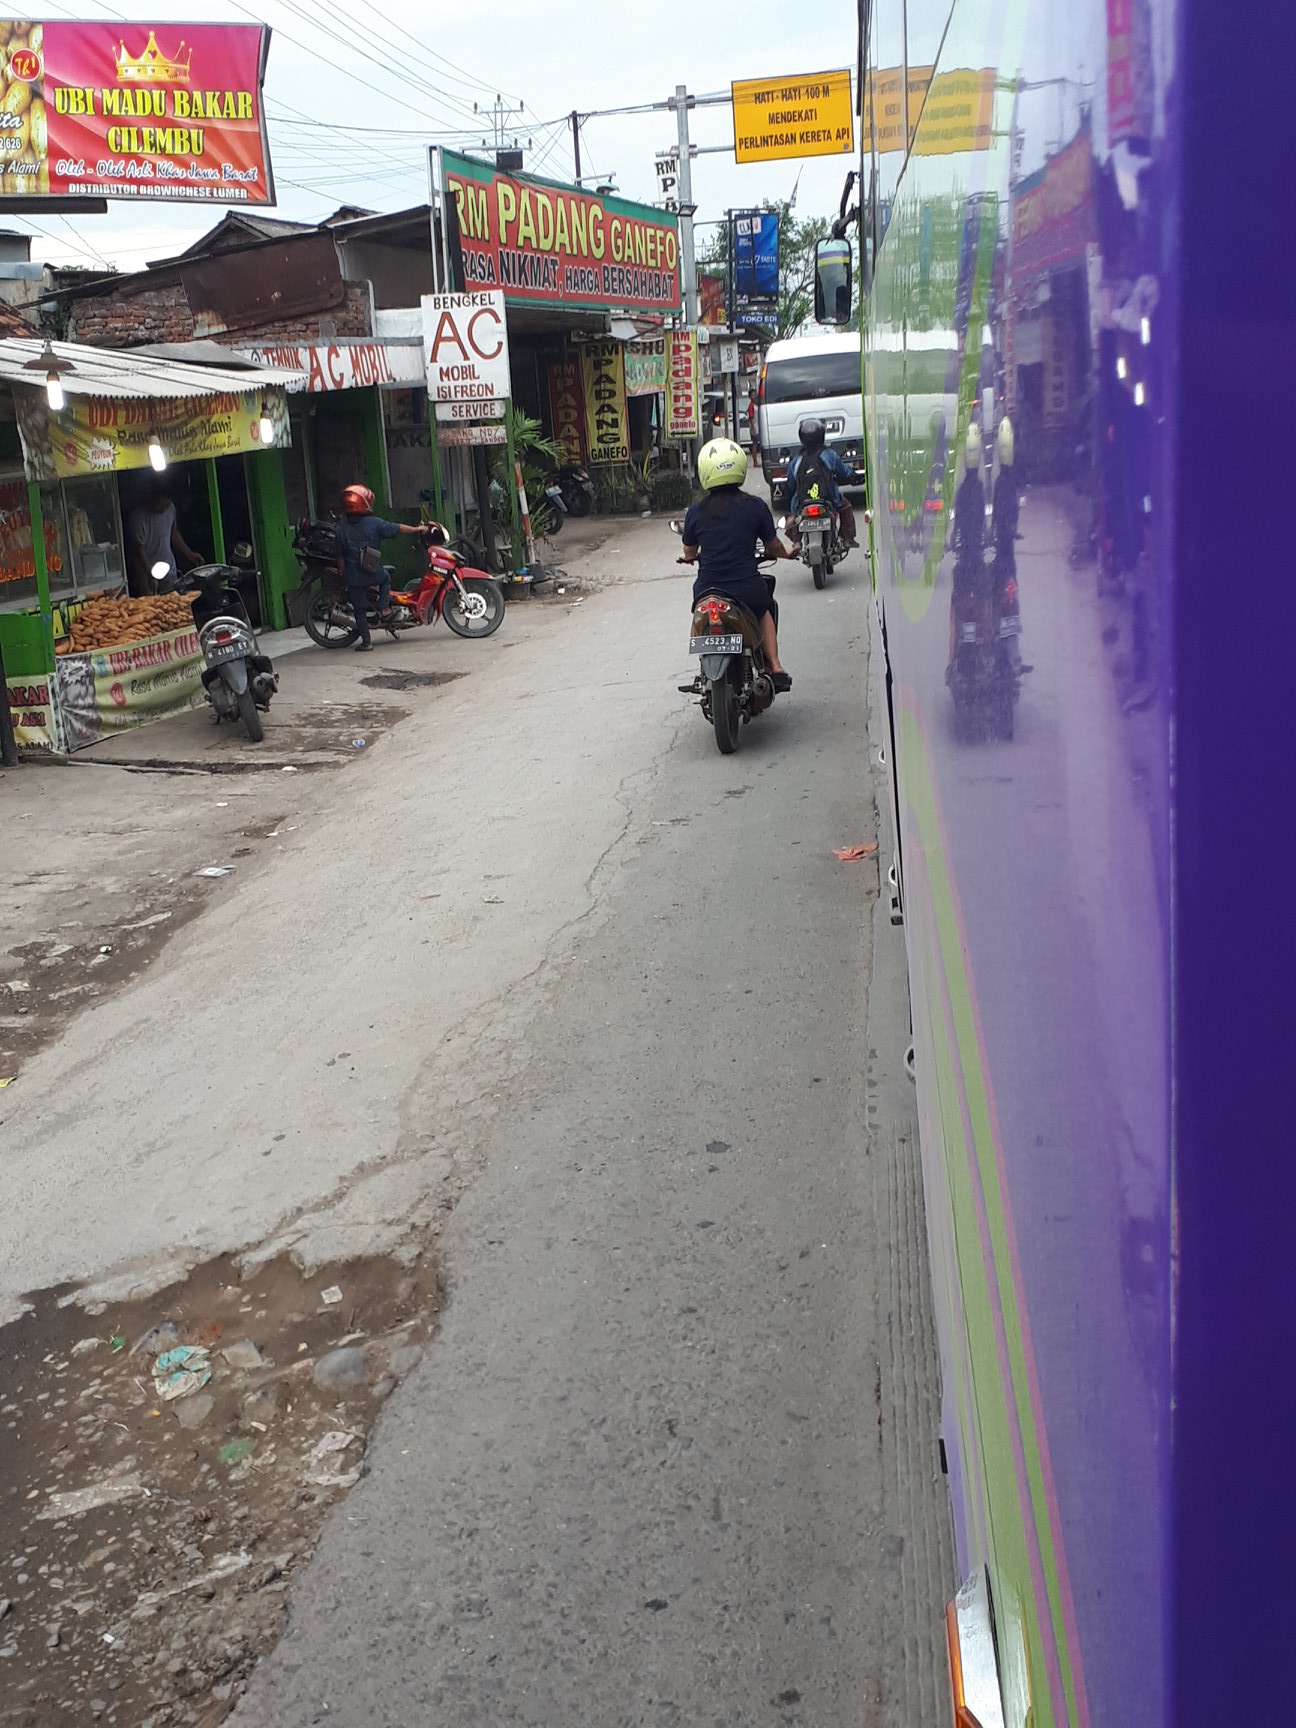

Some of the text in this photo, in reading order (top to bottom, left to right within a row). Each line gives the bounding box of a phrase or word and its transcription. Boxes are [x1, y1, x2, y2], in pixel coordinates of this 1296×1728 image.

[54, 87, 254, 119] UBI MADU BAKAR
[754, 90, 774, 105] HATI
[781, 87, 801, 102] HATI
[806, 86, 821, 100] 100
[822, 84, 830, 98] M
[768, 108, 818, 125] MENDEKATI
[6, 137, 21, 149] 626
[106, 126, 205, 156] CILEMBU
[738, 126, 850, 150] PERLINTASAN KERETA API
[8, 159, 41, 174] Alami
[56, 159, 85, 176] Oleh
[97, 160, 125, 178] Oleh
[126, 161, 154, 178] Asli
[157, 161, 186, 179] Khas
[188, 163, 219, 181] Jawa
[222, 165, 258, 181] Barat
[655, 159, 677, 176] RM
[68, 183, 248, 198] DISTRIBUTOR BROWNCHESE LUMER
[448, 179, 677, 270] RM PADANG GANEFO
[461, 250, 497, 284] RASA
[498, 248, 564, 297] NIKMAT,
[565, 264, 601, 293] HARGA
[601, 263, 674, 301] BERSAHABAT
[433, 293, 495, 310] BENGKEL
[765, 315, 777, 323] EDI
[430, 307, 503, 363] AC
[672, 331, 690, 341] RM
[585, 343, 619, 358] RM
[309, 345, 344, 392] AC
[349, 344, 393, 386] MOBIL
[439, 365, 480, 382] MOBIL
[437, 383, 495, 400] ISI FREON
[452, 402, 496, 418] SERVICE
[593, 359, 621, 444] PADANG
[591, 446, 628, 461] GANEFO
[691, 639, 696, 647] S
[705, 637, 725, 645] 4523
